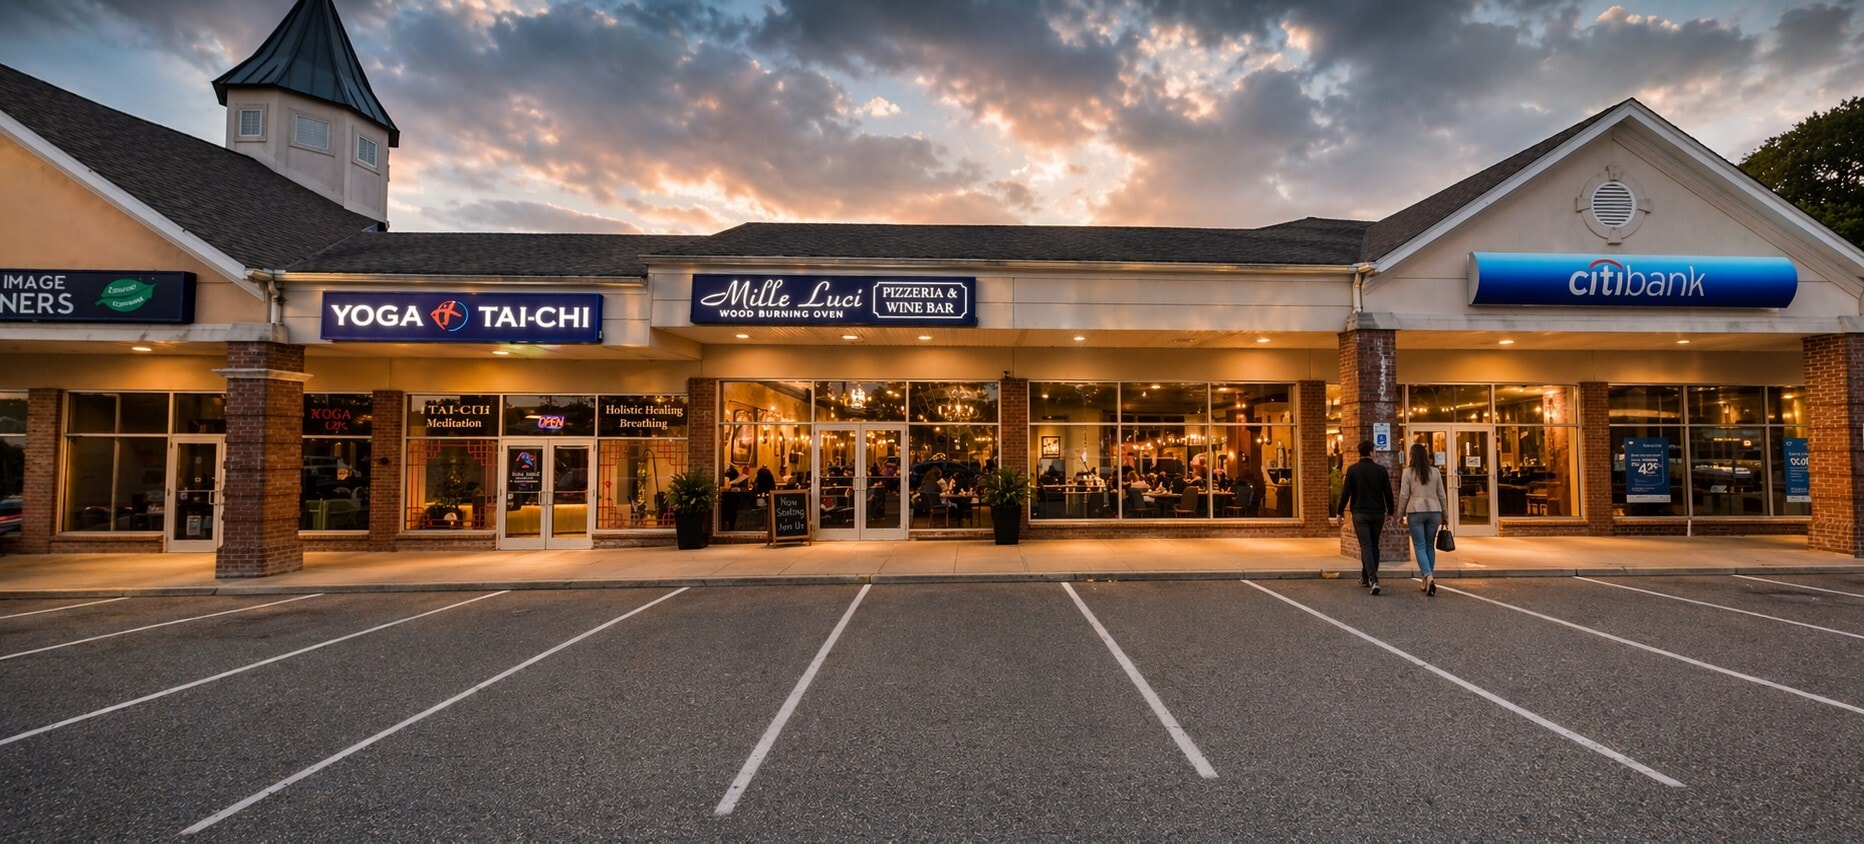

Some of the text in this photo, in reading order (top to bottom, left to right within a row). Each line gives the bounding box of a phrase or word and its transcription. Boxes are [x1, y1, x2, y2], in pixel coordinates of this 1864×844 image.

[3, 275, 66, 290] IMAGE
[1568, 264, 1705, 297] citibank
[700, 279, 863, 308] Mille Luci
[882, 287, 958, 299] PIZZERIA &
[0, 292, 74, 315] NERS
[886, 301, 955, 314] WINE BAR
[331, 304, 590, 328] YOGA TAI-CHI
[720, 310, 844, 318] WOOD BURNING OVEN
[605, 405, 684, 418] Holistic Healing
[426, 418, 482, 428] Meditation
[619, 418, 668, 430] Breathing
